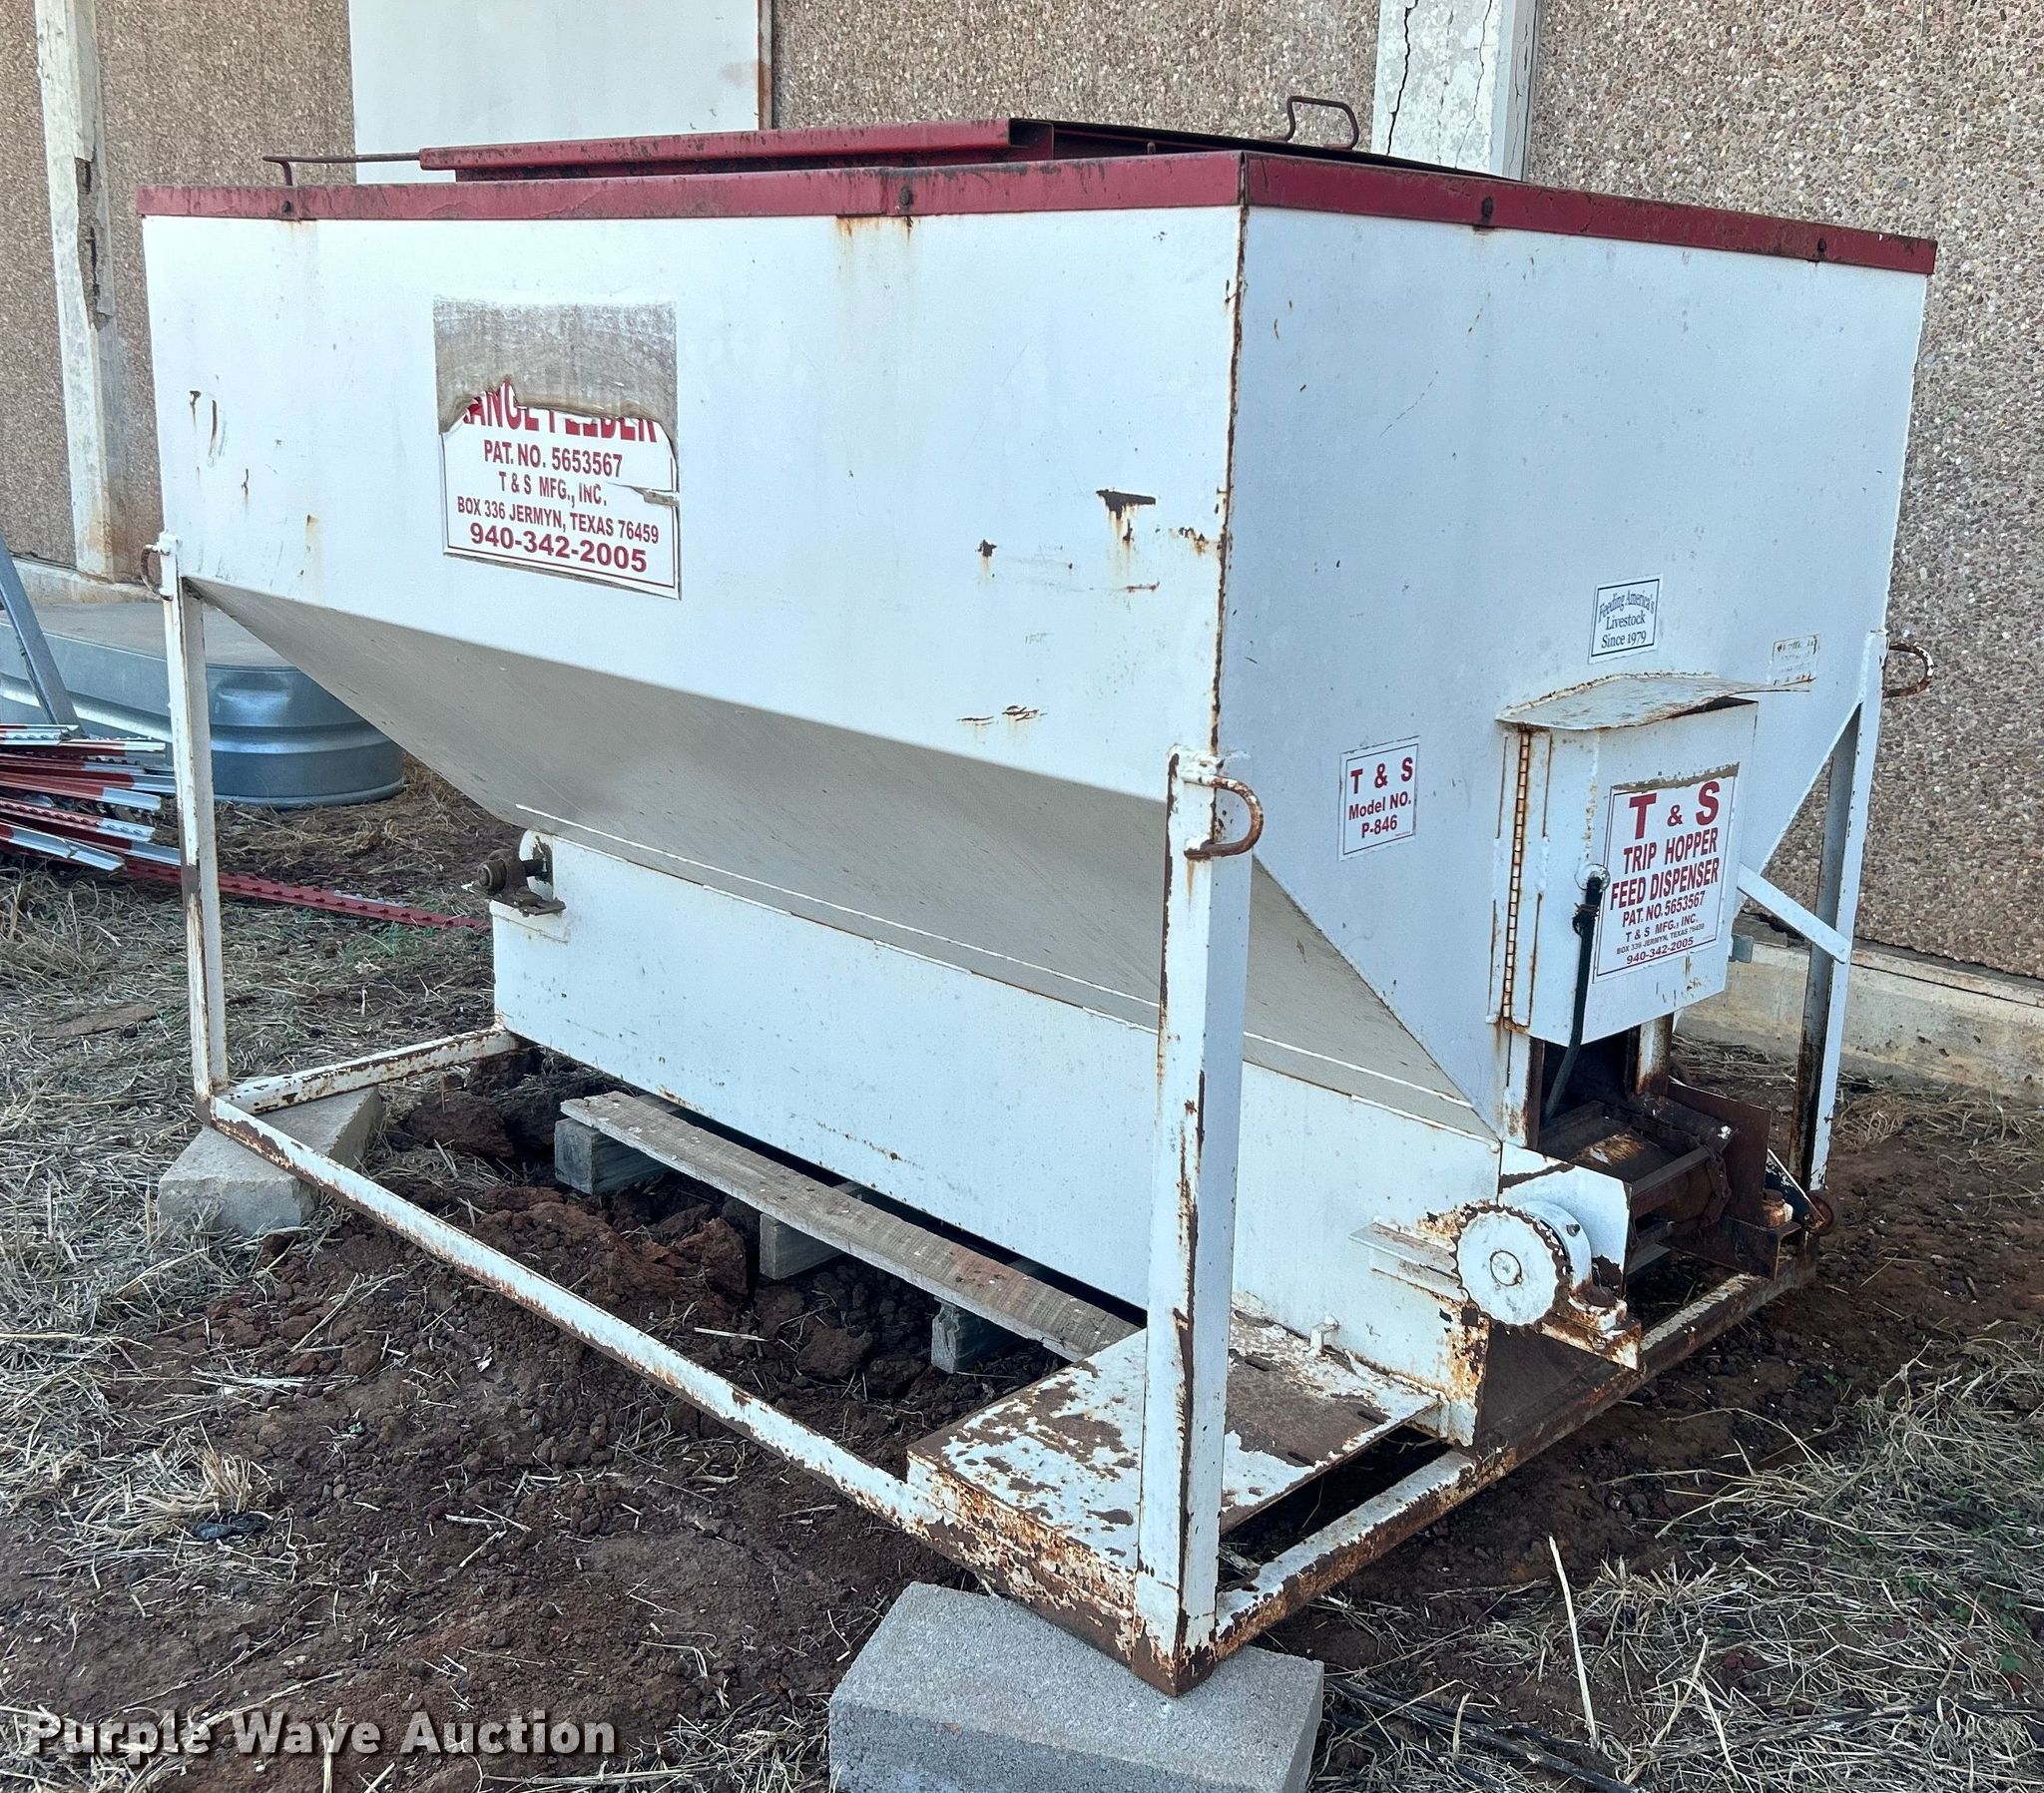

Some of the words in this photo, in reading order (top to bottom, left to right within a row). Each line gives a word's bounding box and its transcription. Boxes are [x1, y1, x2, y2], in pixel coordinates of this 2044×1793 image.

[484, 439, 514, 465] PAT.
[517, 443, 547, 469] NO.
[551, 447, 623, 478] 5653567
[499, 471, 507, 492] T
[511, 473, 521, 495] &
[523, 474, 532, 495] S
[539, 476, 576, 508] MFG.,
[579, 483, 607, 507] INC.
[457, 496, 482, 517] BOX
[484, 499, 506, 520] 336
[509, 504, 567, 533] JERMYN,
[569, 512, 614, 537] TEXAS
[618, 520, 659, 545] 76459
[470, 522, 648, 573] 940-342-2005
[1598, 593, 1625, 623] Feeding
[1625, 590, 1655, 614] America's
[1605, 610, 1646, 631] Livestock
[1601, 633, 1626, 649] Since
[1627, 631, 1647, 647] 1979
[1350, 768, 1363, 794] T
[1374, 762, 1388, 789] &
[1401, 756, 1413, 782] S
[1348, 796, 1386, 821] Model
[1389, 791, 1412, 810] NO.
[1629, 792, 1657, 840] T
[1667, 804, 1684, 827] &
[1696, 780, 1721, 826] S
[1361, 814, 1398, 838] P-846
[1623, 842, 1657, 875] TRIP
[1664, 827, 1719, 865] HOPPER
[1610, 876, 1647, 911] FEED
[1650, 857, 1720, 901] DISPENSER
[1622, 907, 1644, 928] PAT.
[1646, 903, 1664, 922] NO.
[1664, 890, 1706, 918] 5653567
[1616, 945, 1630, 955] BOX
[1670, 928, 1689, 939] TEXAS
[1625, 931, 1632, 943] T
[1634, 929, 1641, 941] &
[1644, 926, 1651, 938] S
[1681, 913, 1698, 927] INC.
[1626, 936, 1694, 965] 940-342-2005
